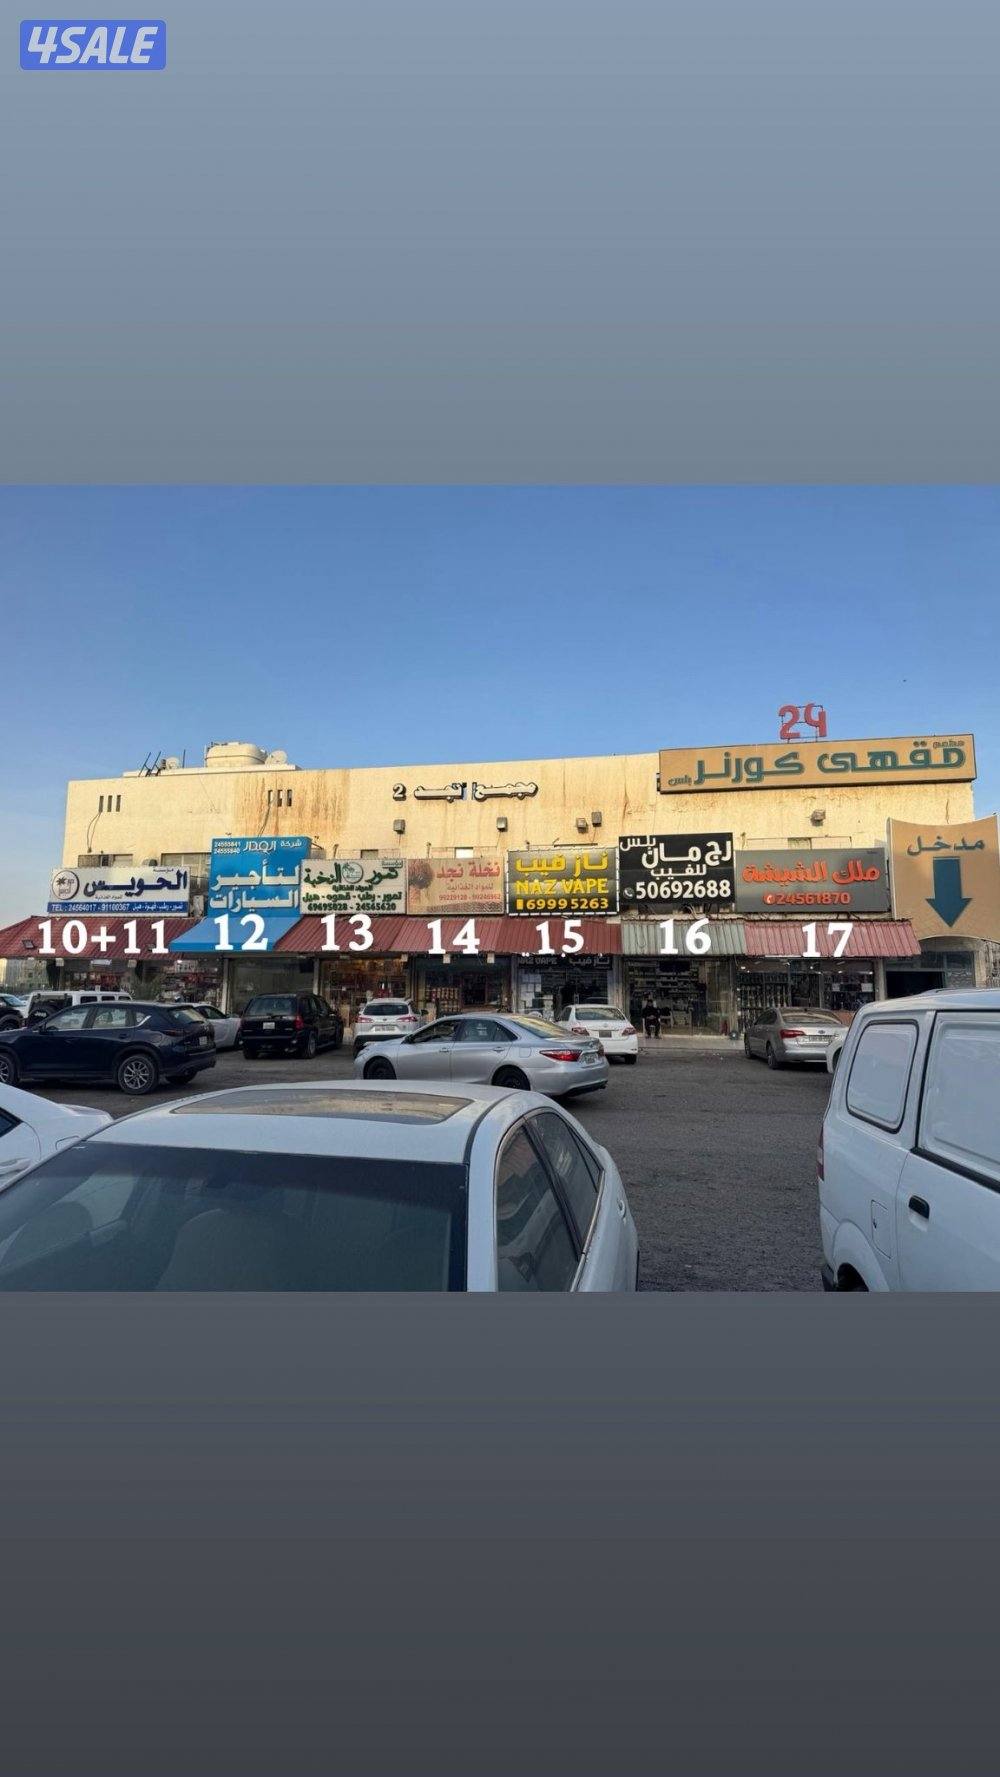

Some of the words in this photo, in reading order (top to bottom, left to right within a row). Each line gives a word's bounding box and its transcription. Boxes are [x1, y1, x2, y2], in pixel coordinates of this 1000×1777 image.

[816, 740, 966, 773] مقهى
[693, 751, 805, 785] كورنر
[393, 783, 406, 801] 2
[907, 835, 986, 857] مدخل
[211, 859, 300, 891] لتأجير
[468, 861, 501, 877] نخلة
[742, 859, 827, 887] الشيشة
[832, 859, 880, 885] ملك
[515, 880, 556, 895] NAZ
[562, 879, 609, 894] VAPE
[636, 880, 731, 899] 50692688
[210, 889, 299, 913] السيارات
[526, 898, 609, 910] 69995263
[776, 892, 851, 904] 24561870
[535, 957, 558, 965] VAPE
